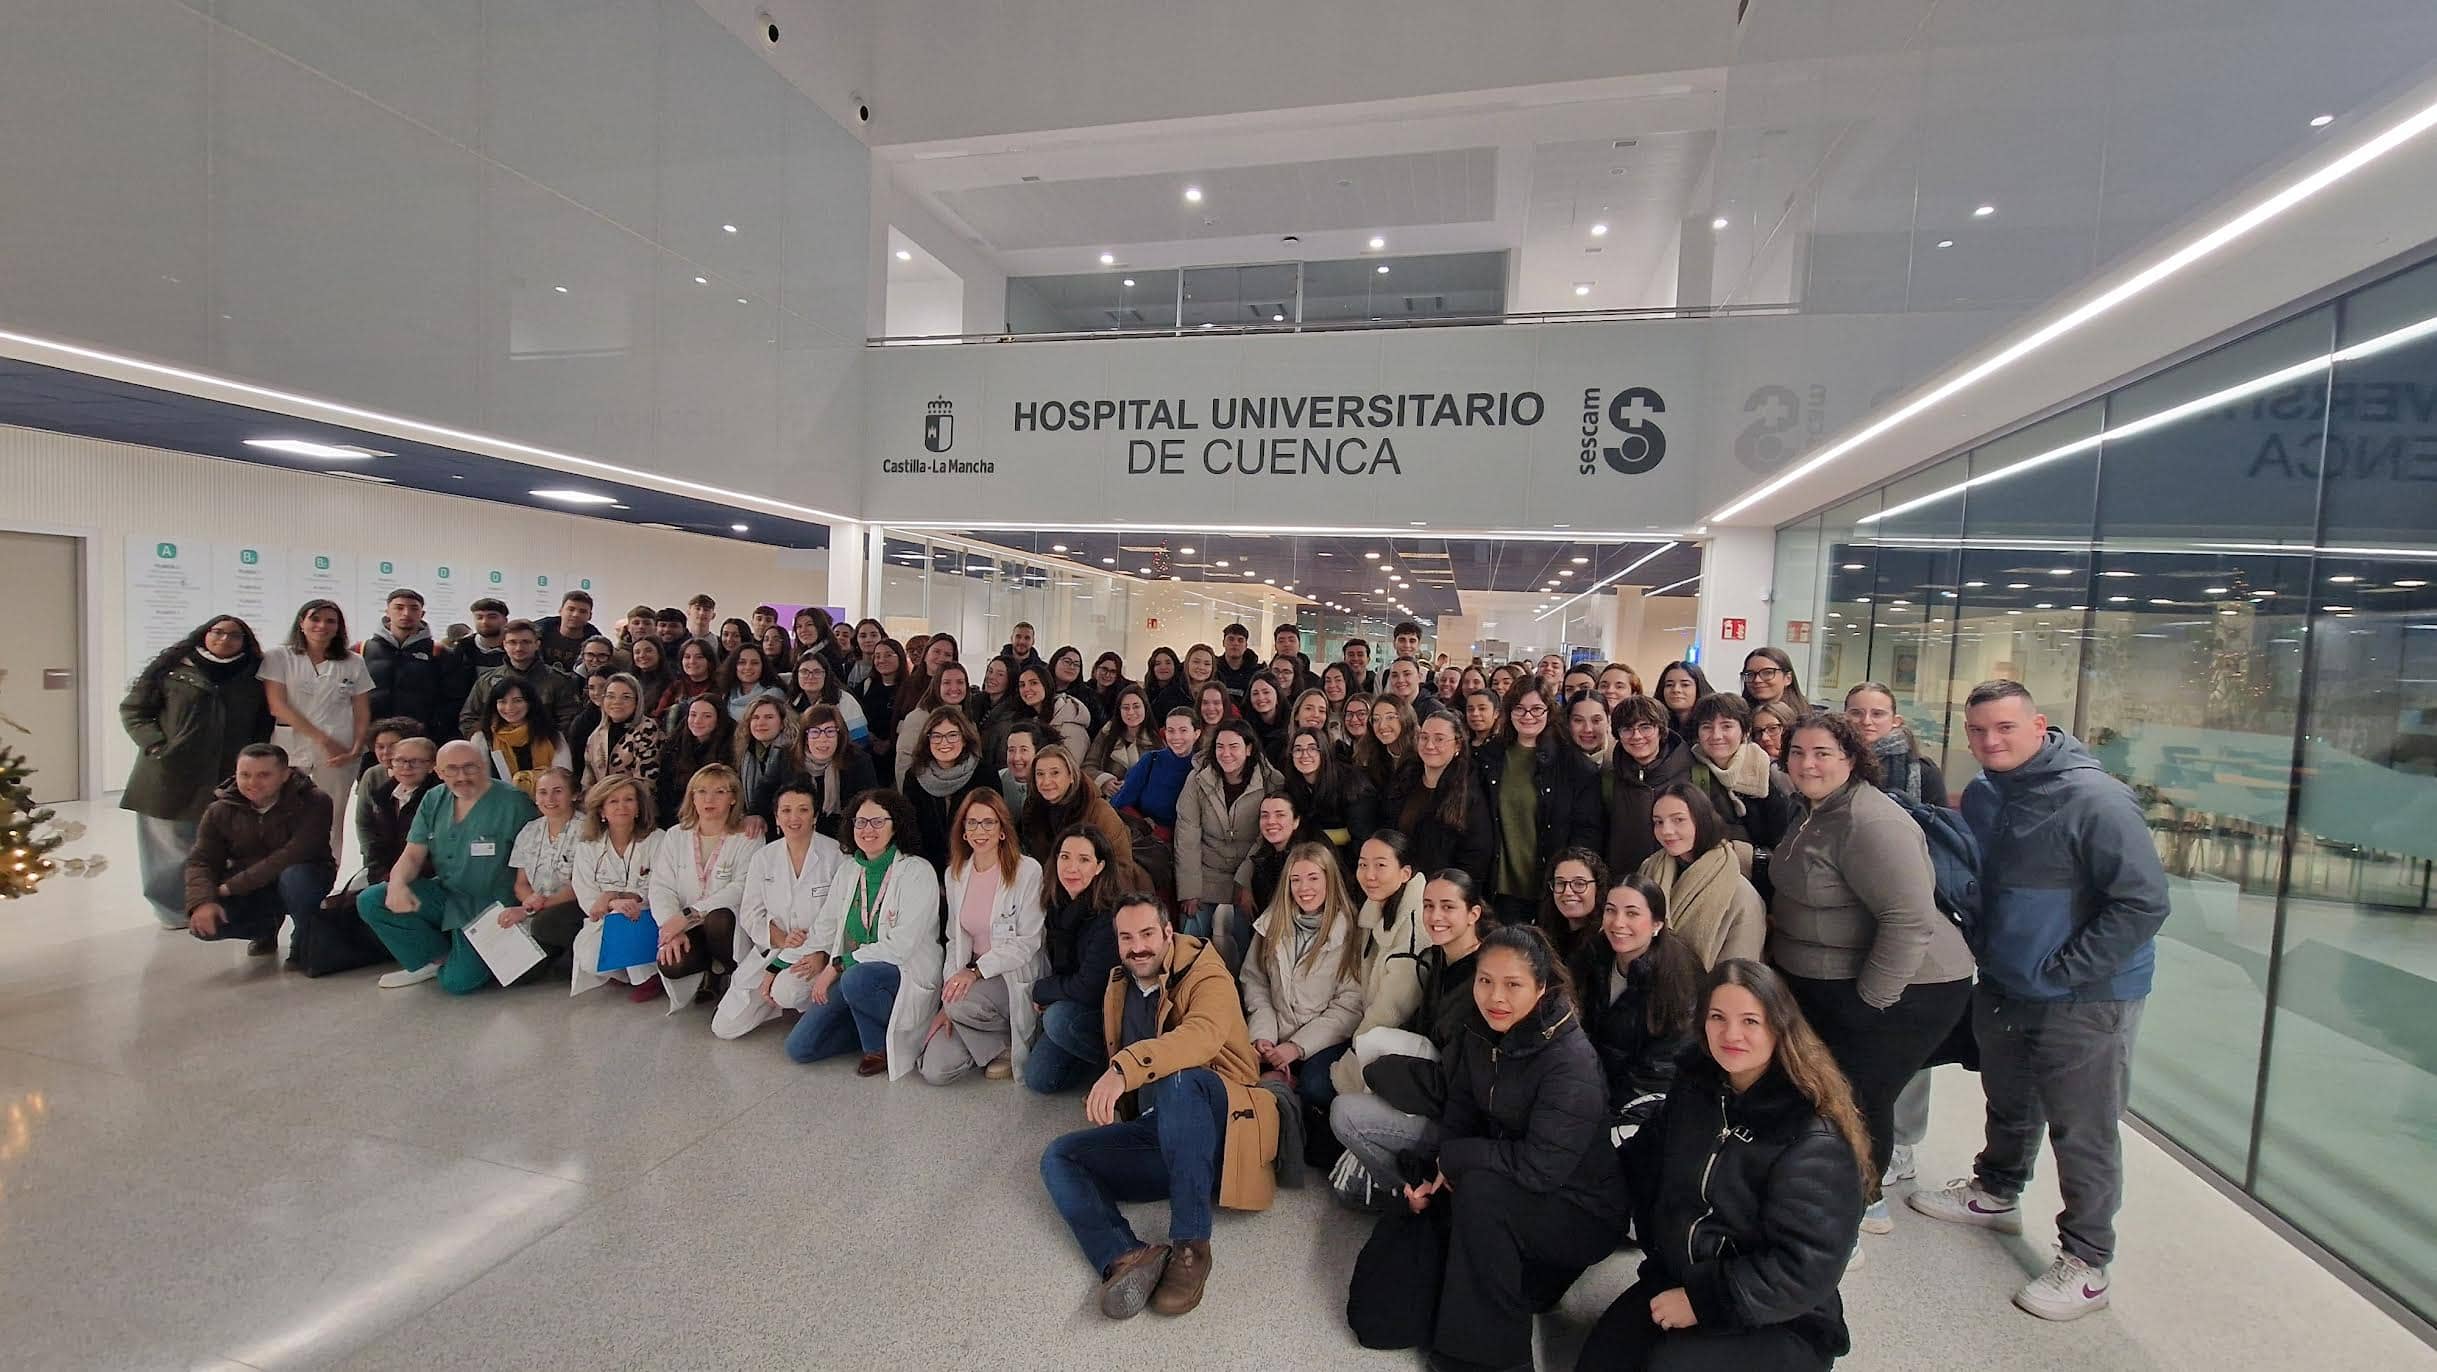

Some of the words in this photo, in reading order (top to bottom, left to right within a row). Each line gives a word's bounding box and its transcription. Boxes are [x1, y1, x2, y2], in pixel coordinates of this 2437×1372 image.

[1014, 399, 1199, 432] HOSPITAL
[1212, 391, 1545, 430] UNIVERSITARIO
[1579, 387, 1601, 476] sescam
[948, 458, 995, 474] Mancha
[1128, 439, 1186, 475] DE
[1202, 437, 1402, 475] CUENCA
